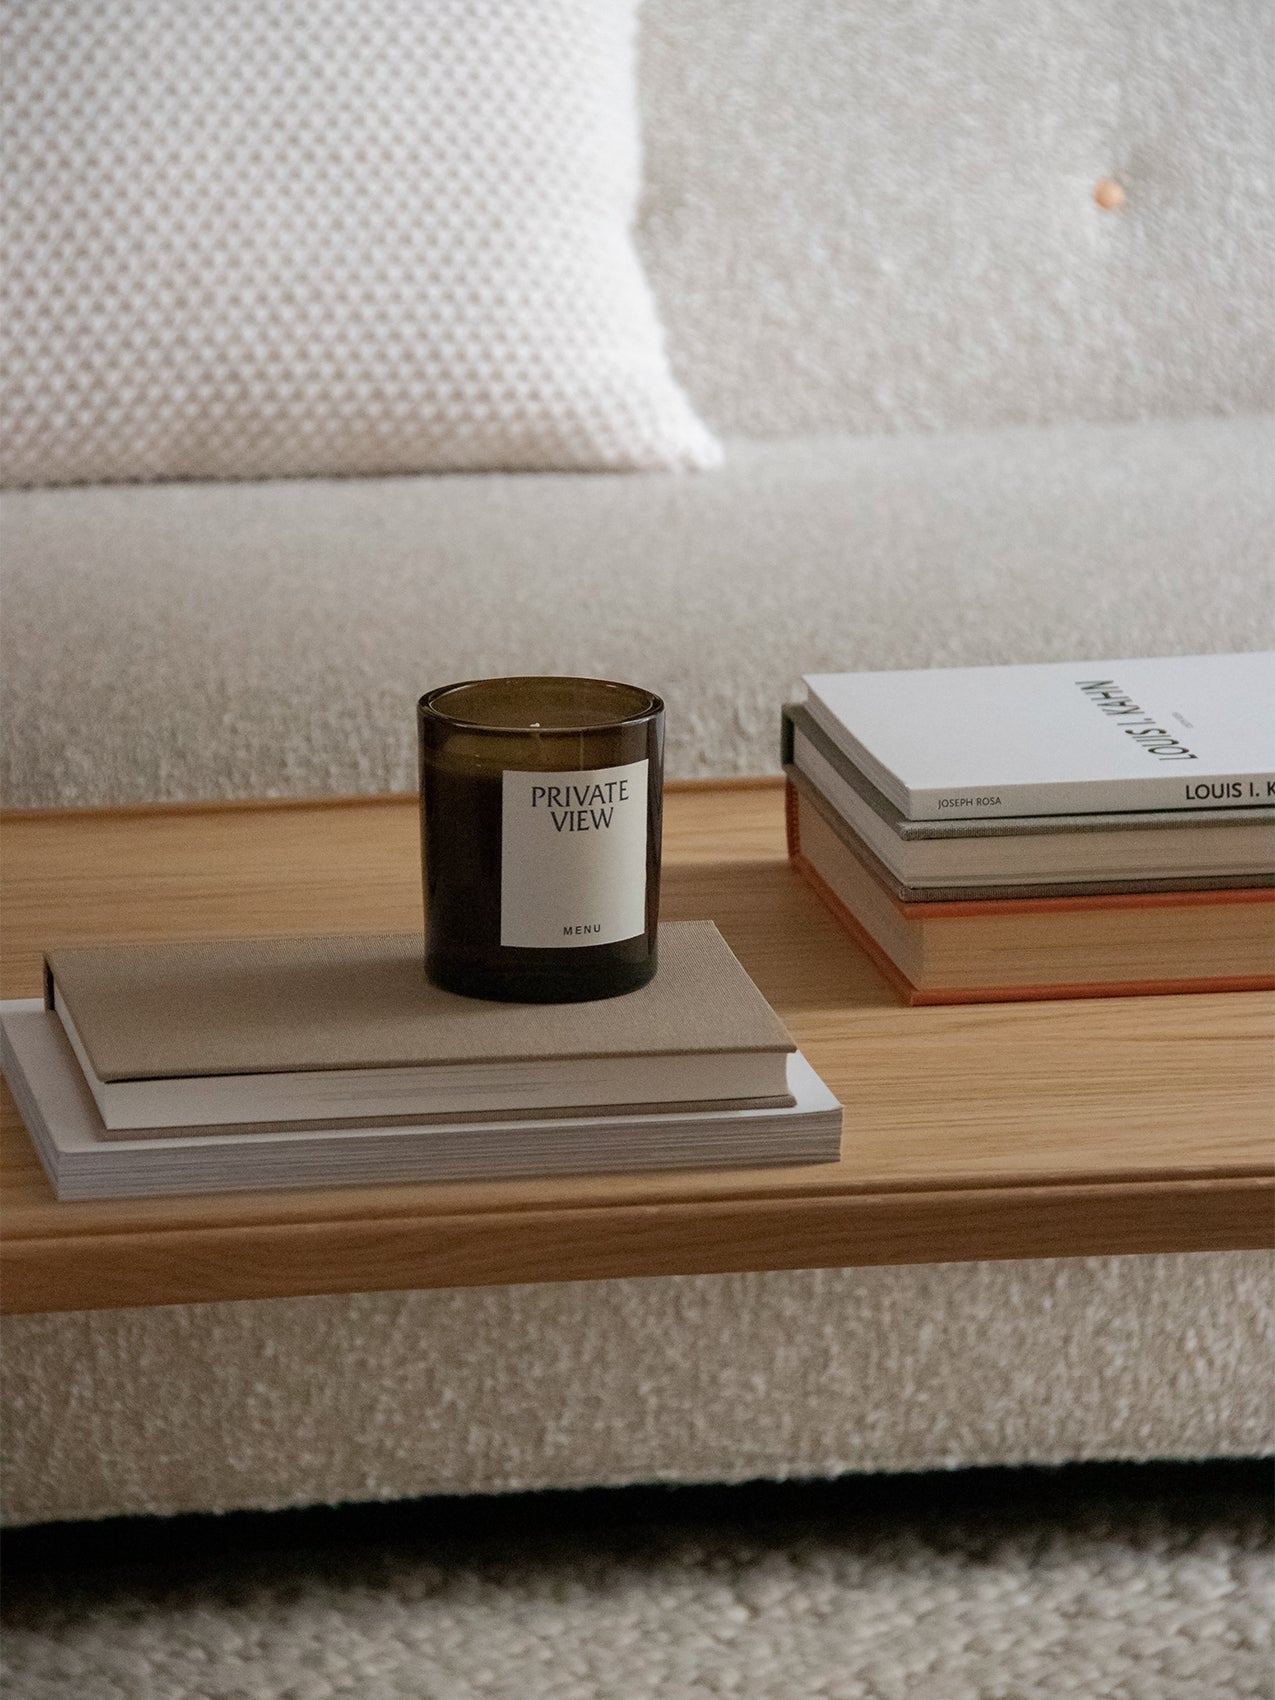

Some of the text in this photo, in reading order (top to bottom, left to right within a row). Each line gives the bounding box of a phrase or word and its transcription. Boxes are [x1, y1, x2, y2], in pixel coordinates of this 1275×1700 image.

[1075, 680, 1145, 716] KAHN
[1124, 728, 1198, 761] LOUIS
[531, 779, 629, 808] PRIVATE
[938, 796, 1002, 810] JOSEPH ROSA
[1185, 782, 1243, 800] LOUIS
[1249, 781, 1260, 797] I.
[550, 807, 614, 832] VIEW
[563, 924, 601, 936] MENU
